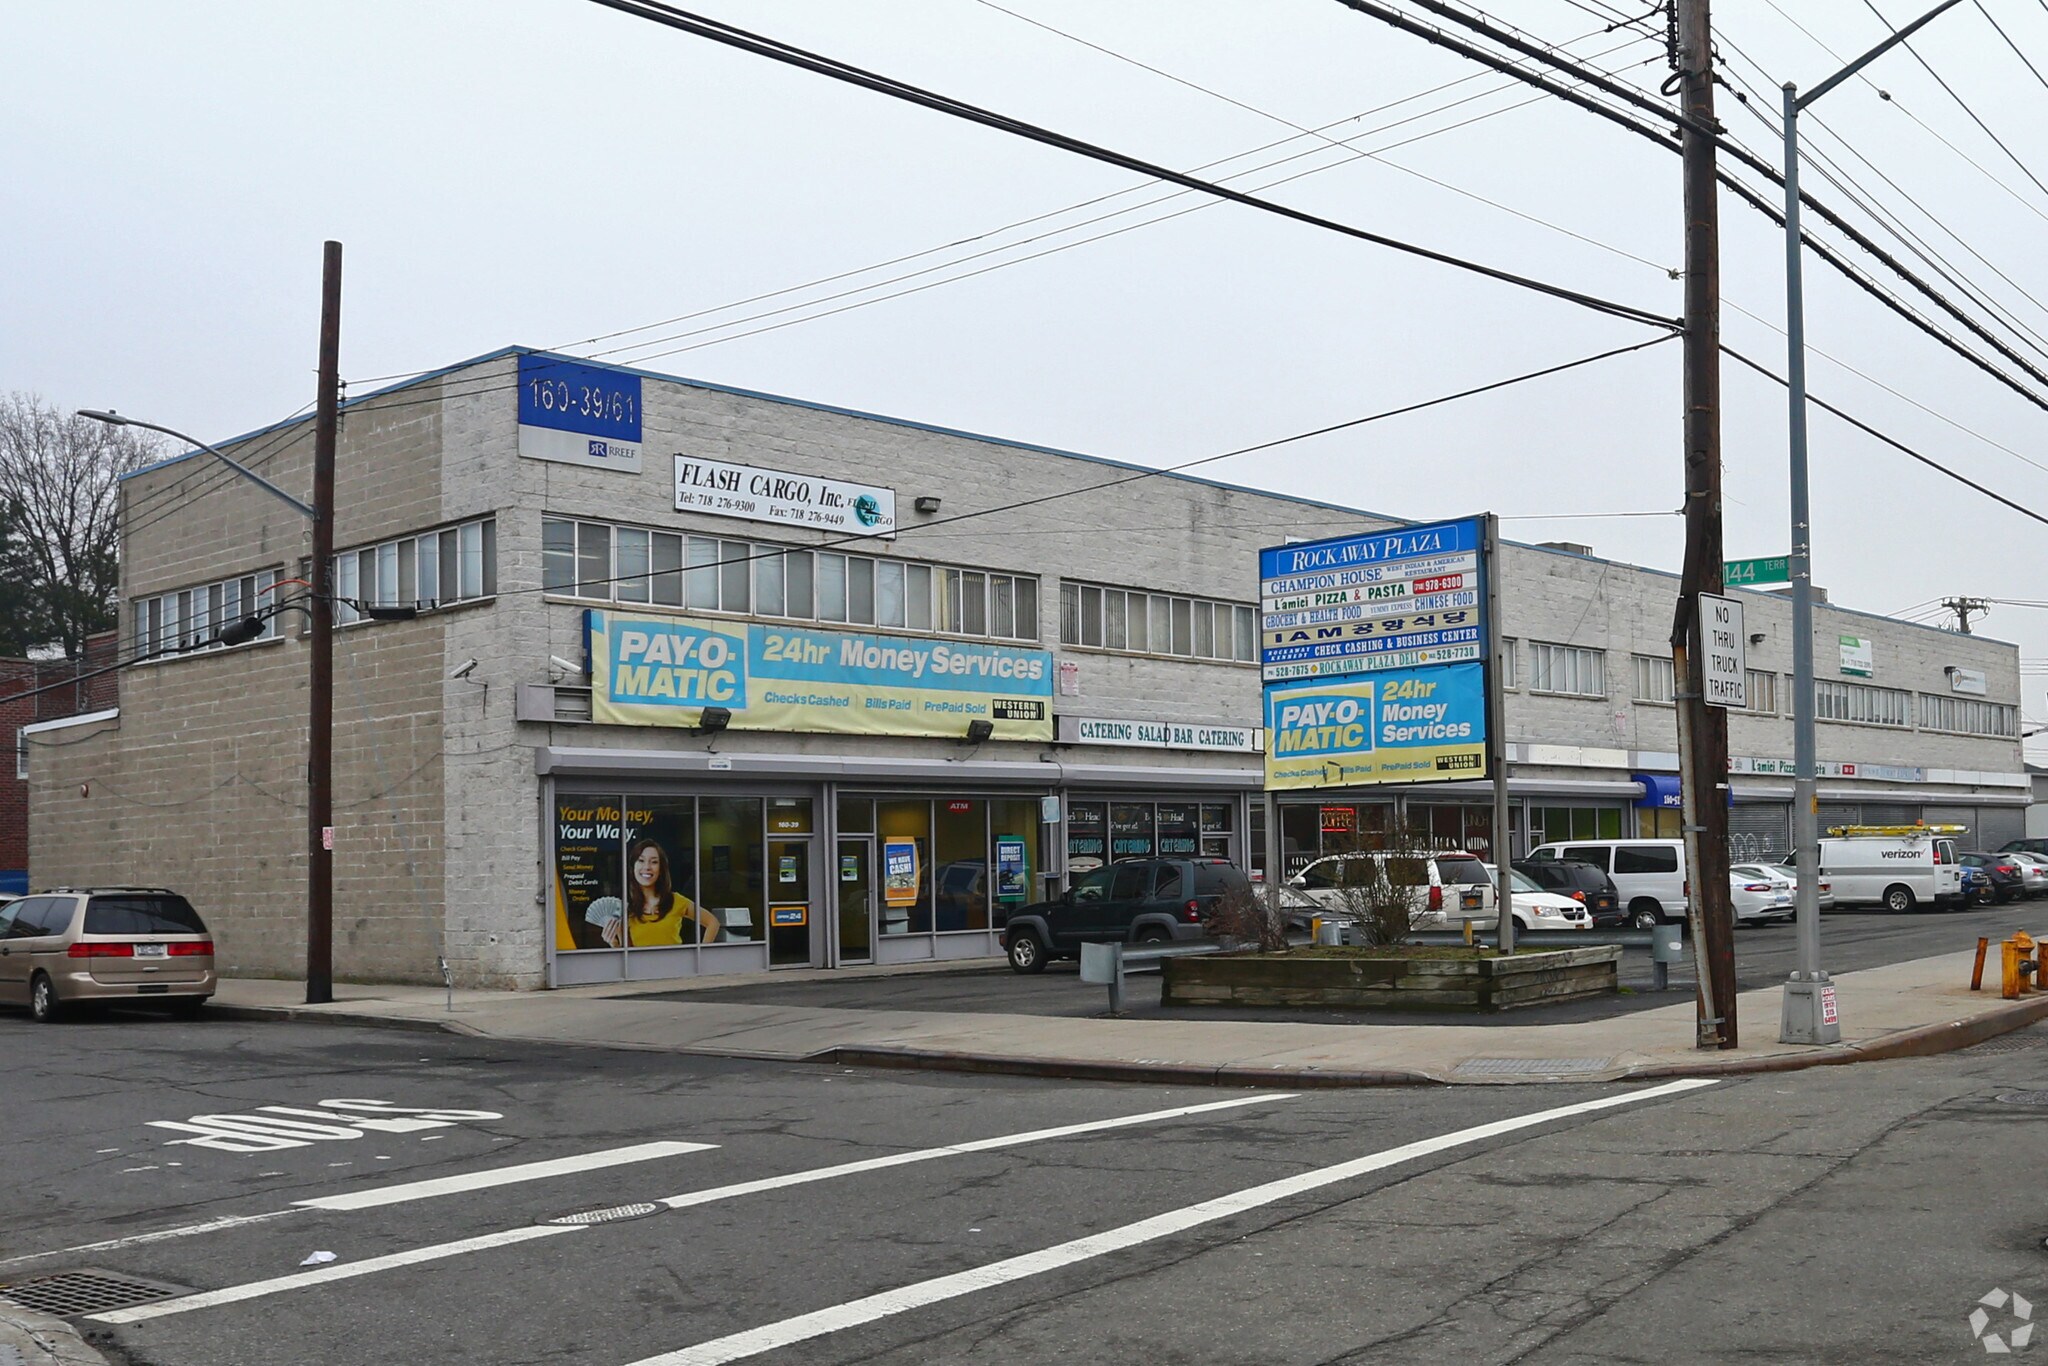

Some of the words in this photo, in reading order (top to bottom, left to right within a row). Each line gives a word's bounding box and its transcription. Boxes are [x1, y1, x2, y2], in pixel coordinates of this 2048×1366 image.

[609, 448, 636, 458] RREEF
[680, 464, 741, 492] FLASH
[750, 475, 812, 505] CARGO,
[819, 486, 845, 508] Inc.
[679, 491, 695, 504] Tel:
[698, 495, 713, 506] 718
[717, 497, 755, 513] 276-9300
[769, 505, 787, 517] Fax:
[790, 508, 805, 520] 718
[808, 511, 845, 525] 276-9449
[1291, 541, 1380, 572] ROCKAWAY
[1382, 533, 1441, 559] PLAZA
[1404, 562, 1425, 570] INDIAN
[1433, 556, 1465, 566] AMERICAN
[1404, 566, 1446, 577] RESTAURANT
[1764, 559, 1785, 571] TERR
[1271, 574, 1336, 594] CHAMPION
[1340, 568, 1383, 585] HOUSE
[1425, 576, 1461, 592] 978-6300
[1275, 596, 1309, 610] L'amici
[1315, 592, 1347, 606] PIZZA
[1354, 589, 1361, 600] &
[1368, 584, 1405, 600] PASTA
[1415, 594, 1448, 611] CHINESE
[1453, 591, 1473, 606] FOOD
[1266, 613, 1298, 628] GROCERY
[1310, 608, 1339, 623] HEALTH
[1342, 605, 1361, 620] FOOD
[1716, 606, 1729, 624] NO
[1314, 644, 1342, 656] CHECK
[1345, 639, 1383, 653] CASHING
[1387, 638, 1393, 648] &
[1396, 633, 1438, 647] BUSINESS
[1442, 628, 1478, 642] CENTER
[1713, 630, 1735, 649] THRU
[762, 635, 830, 665] 24hr
[839, 639, 928, 677] Money
[930, 646, 1043, 680] Services
[1320, 657, 1364, 673] ROCKAWAY
[1368, 654, 1395, 670] PLAZA
[1399, 651, 1419, 665] DELI
[1437, 647, 1474, 660] 528-7730
[1711, 654, 1738, 674] TRUCK
[615, 664, 735, 701] MATIC
[1382, 680, 1436, 701] 24hr
[1709, 679, 1743, 699] TRAFFIC
[765, 691, 807, 705] Checks
[808, 694, 849, 707] Cashed
[865, 697, 888, 709] Bills
[888, 699, 911, 710] Paid
[924, 701, 963, 714] PrePaid
[964, 703, 986, 714] Sold
[995, 701, 1036, 712] WESTERN
[1007, 710, 1036, 719] UNION
[1382, 702, 1448, 722] Money
[1080, 722, 1132, 740] CATERING
[1138, 725, 1171, 742] SALAD
[1174, 728, 1193, 744] BAR
[1199, 730, 1244, 746] CATERING
[1278, 724, 1364, 752] MATIC
[1383, 722, 1471, 743] Services
[1355, 765, 1372, 773] Paid
[1413, 761, 1430, 769] Sold
[1437, 756, 1474, 764] WESTERN
[1752, 758, 1775, 772] L'amici
[1274, 771, 1299, 779] Checks
[560, 807, 594, 821] Your
[596, 807, 654, 825] Money,
[560, 824, 594, 839] Your
[596, 824, 637, 843] Way.
[1000, 846, 1021, 854] DIRECT
[1068, 839, 1103, 853] ATERING
[1881, 848, 1920, 858] verizon
[889, 857, 899, 865] WE
[899, 856, 911, 864] HAVE
[1000, 854, 1021, 862] DEPOSIT
[889, 863, 912, 875] CASH!
